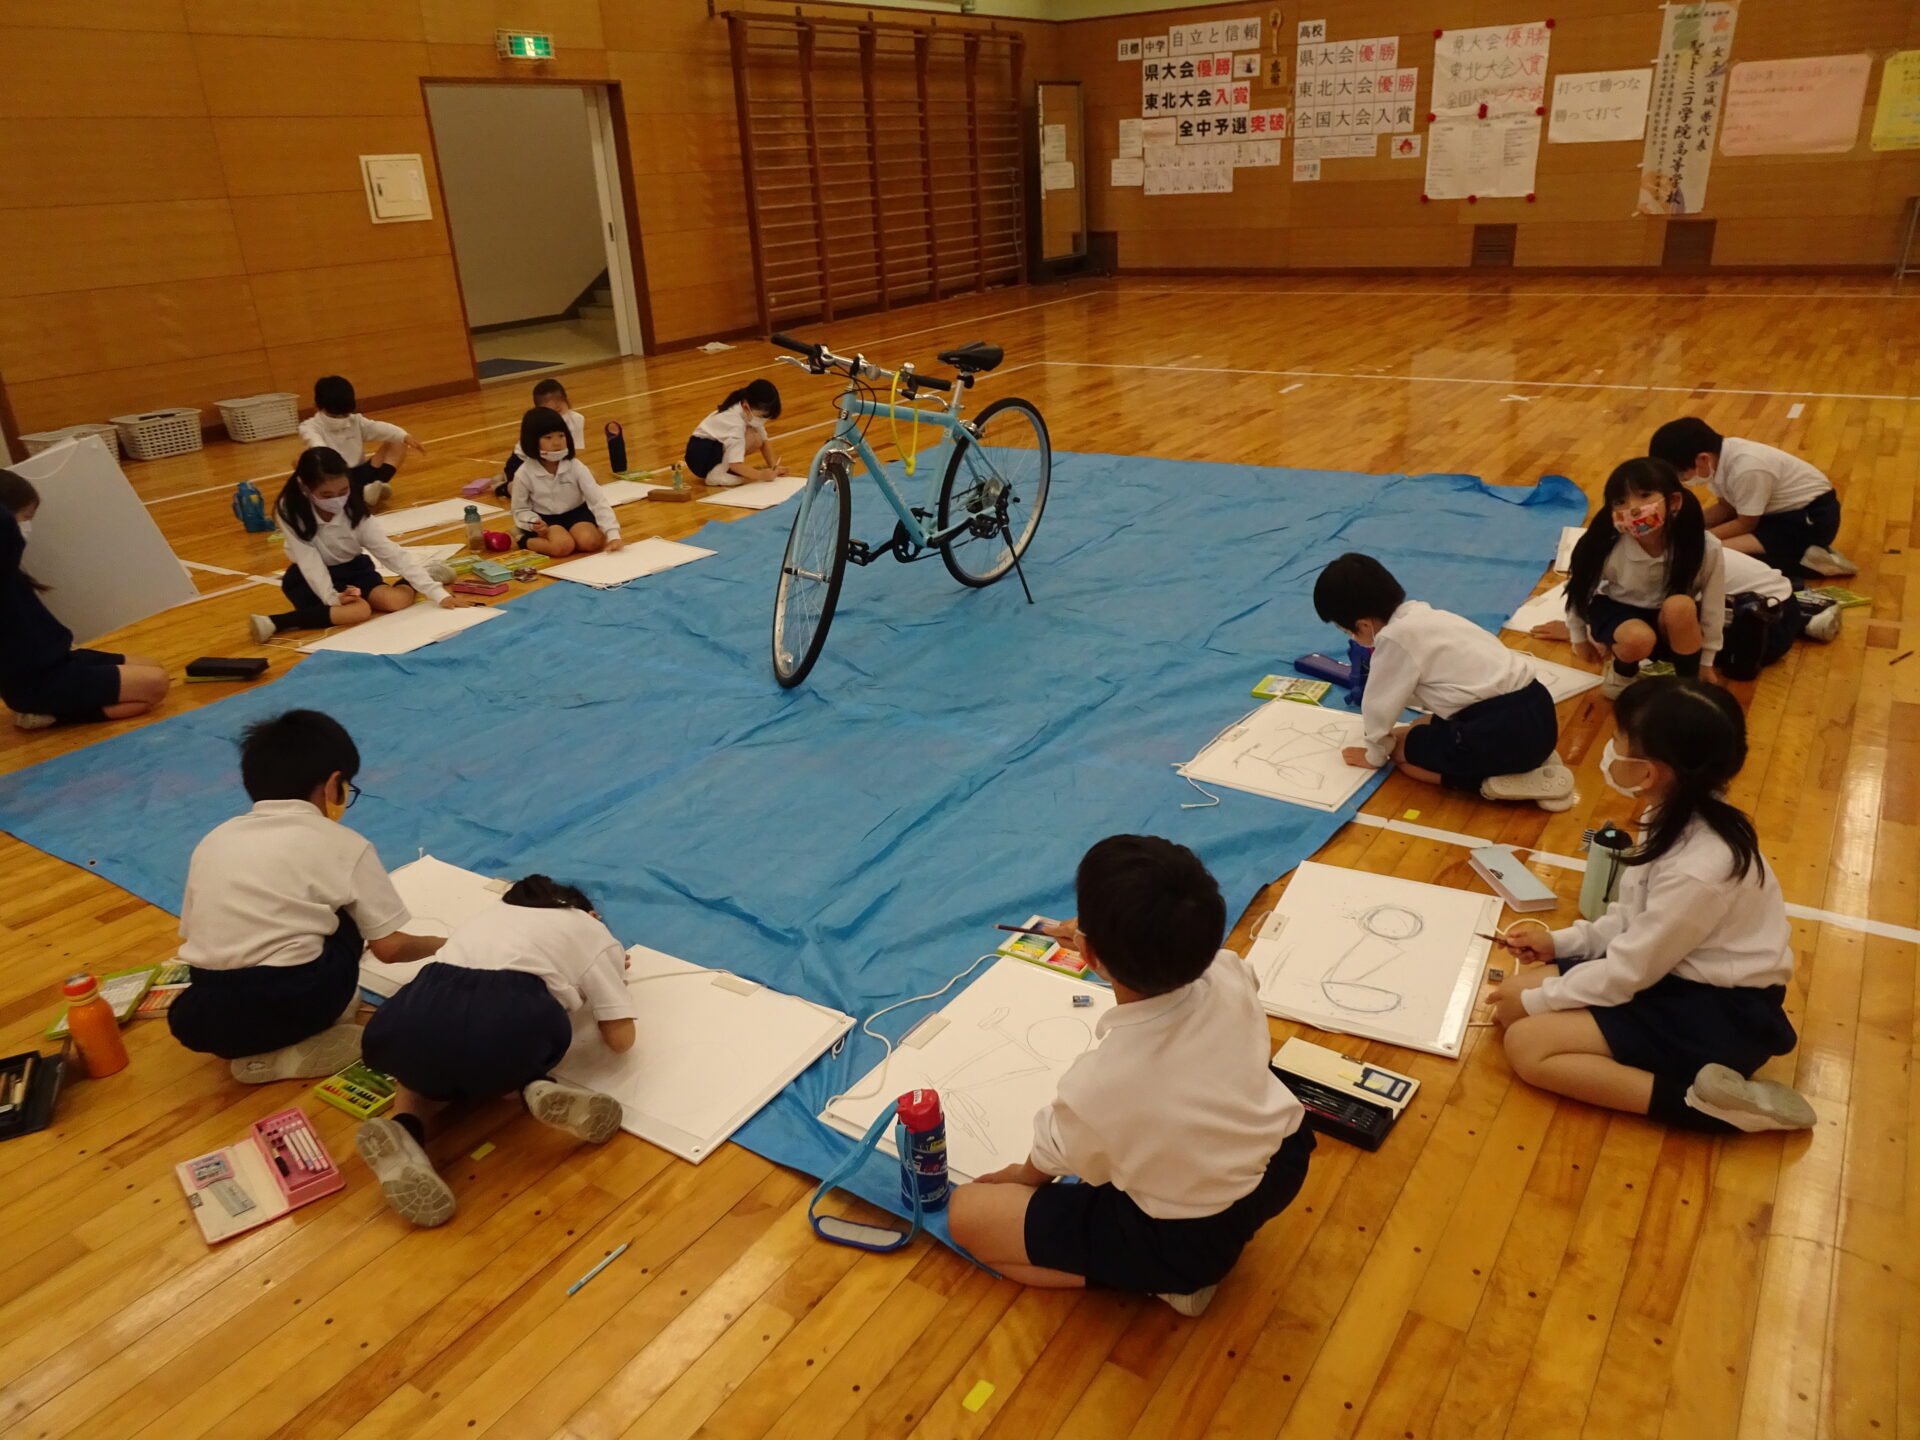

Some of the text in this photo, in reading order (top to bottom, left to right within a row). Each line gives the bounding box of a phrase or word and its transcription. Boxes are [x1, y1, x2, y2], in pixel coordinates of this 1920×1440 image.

[1172, 23, 1259, 48] 自立と信頼
[1299, 24, 1324, 39] 高校
[1120, 42, 1140, 56] 目標
[1145, 40, 1166, 53] 中学
[1299, 42, 1396, 67] 県大会優勝
[1144, 57, 1232, 81] 県大会優勝
[1297, 74, 1415, 98] 東北大会優勝
[1144, 86, 1249, 111] 東北大会入賞
[1178, 113, 1285, 138] 全中予選突破
[1297, 106, 1413, 129] 全国大会入賞
[1666, 39, 1705, 205] 聖ドミニコ学院高等学校
